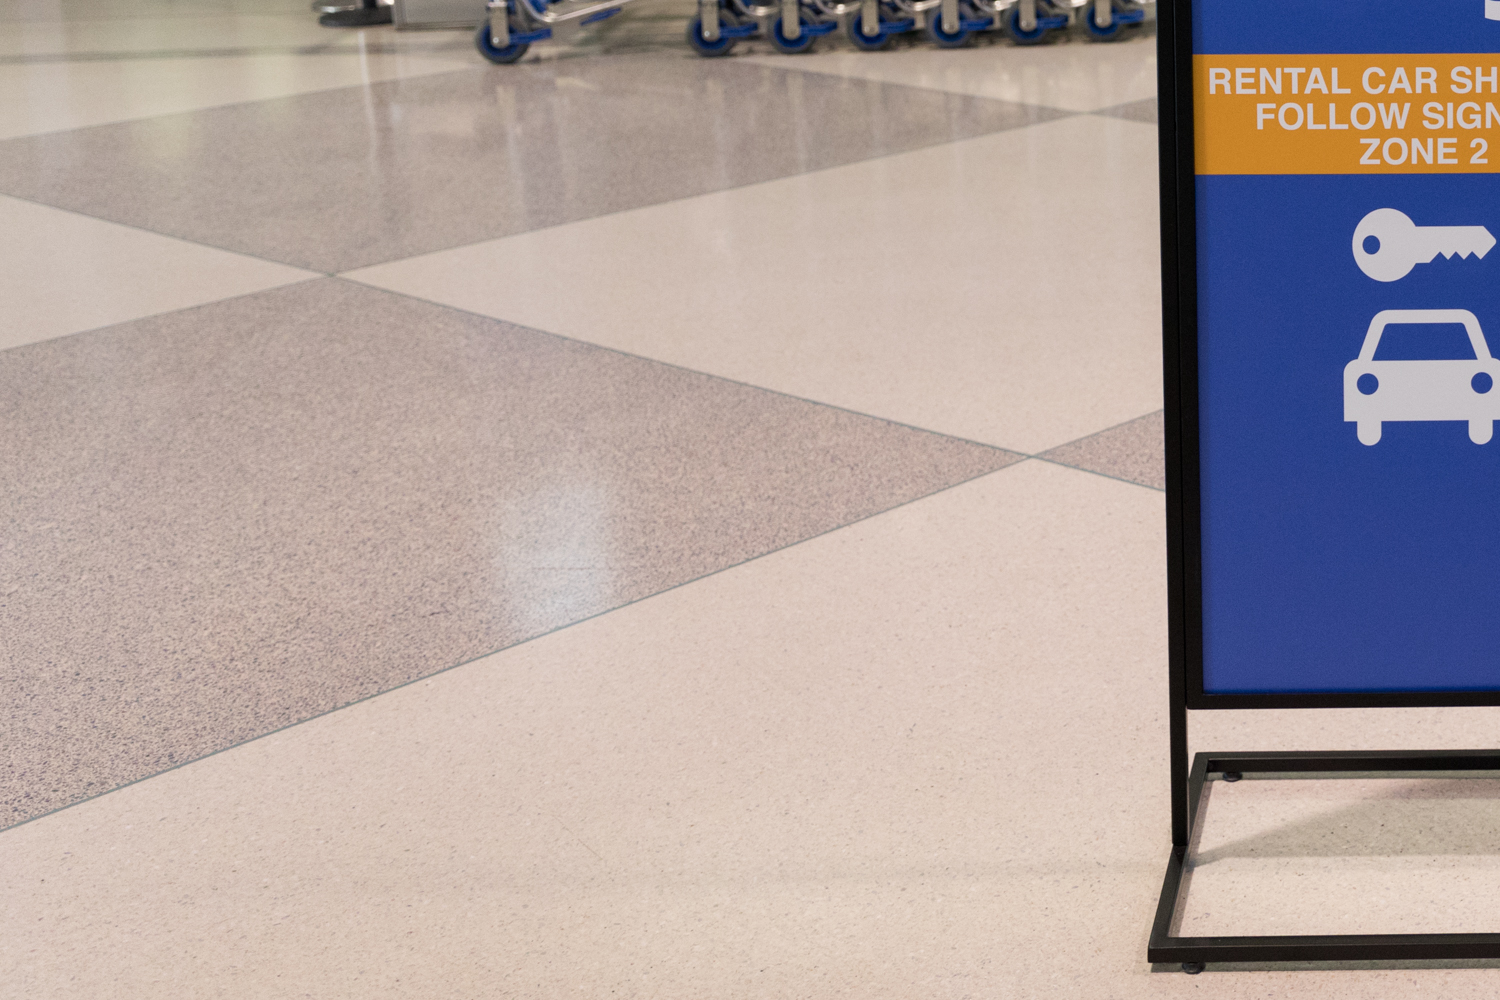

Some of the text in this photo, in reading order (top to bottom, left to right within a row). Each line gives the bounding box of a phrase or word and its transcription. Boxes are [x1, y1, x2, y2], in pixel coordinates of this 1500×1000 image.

[1208, 67, 1352, 95] RENTAL
[1361, 66, 1438, 94] CAR
[1256, 102, 1411, 130] FOLLOW
[1359, 137, 1489, 165] ZONE 2
